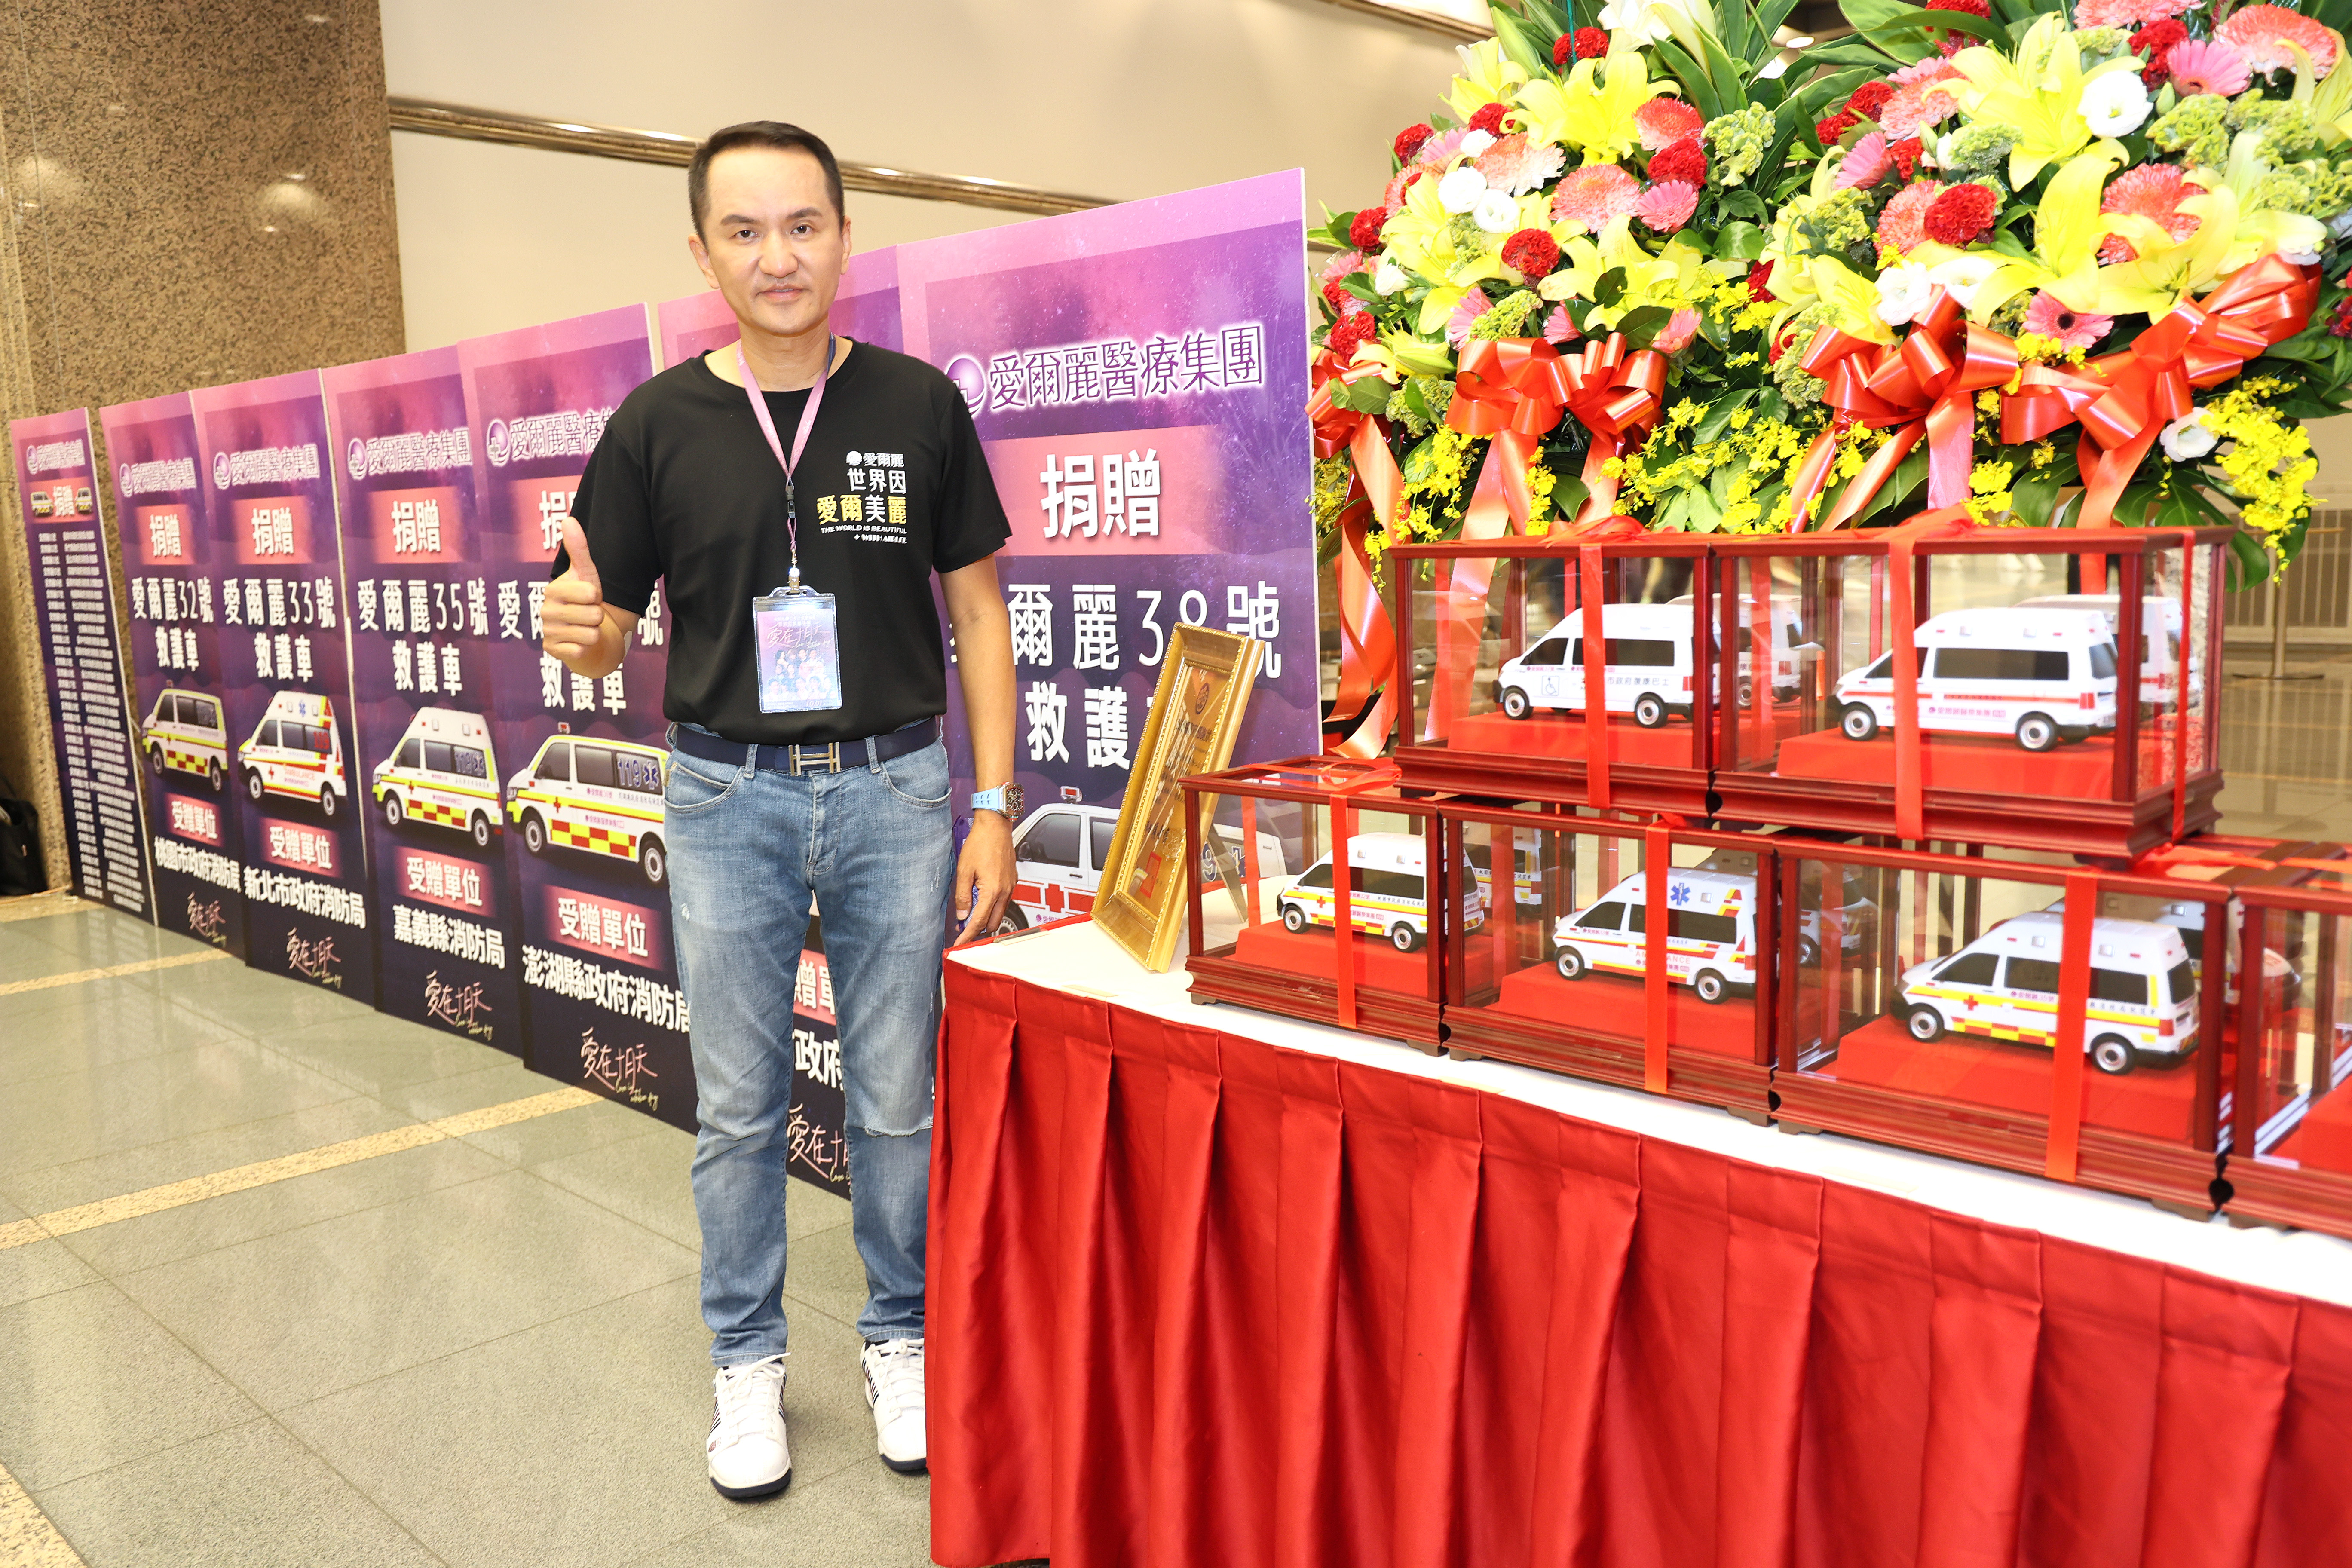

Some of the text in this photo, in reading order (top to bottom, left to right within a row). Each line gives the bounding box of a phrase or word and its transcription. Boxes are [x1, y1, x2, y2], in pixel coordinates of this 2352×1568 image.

[989, 325, 1262, 410] 愛爾麗醫療集團
[367, 429, 472, 475] 愛爾麗醫療集團
[511, 410, 614, 458] 愛爾麗醫療
[847, 468, 906, 494] 世界因
[863, 453, 904, 467] 愛爾麗
[817, 494, 906, 525] 愛爾美麗
[1039, 448, 1161, 539] 捐贈
[251, 507, 294, 555] 捐贈
[391, 499, 441, 553] 捐贈
[539, 490, 577, 549] 捐
[871, 526, 907, 534] BEAUTIFUL
[132, 576, 214, 623] 愛爾麗32號
[223, 576, 337, 628] 愛爾麗33號
[357, 577, 489, 636] 愛爾麗35號
[155, 628, 200, 671] 救護車
[950, 581, 1281, 679] 爾麗3號
[254, 632, 314, 682] 救護車
[392, 640, 463, 696] 救護車
[1025, 681, 1154, 771] 救護
[618, 758, 642, 787] 119
[171, 801, 218, 839] 受贈單位
[270, 825, 332, 869] 受贈單位
[244, 865, 366, 929] 新北市政府消防局
[407, 857, 483, 908] 受贈單位
[393, 904, 505, 969] 嘉義縣消防局
[558, 897, 649, 958] 受贈單位
[521, 944, 689, 1033] 澎湖縣政府消防局
